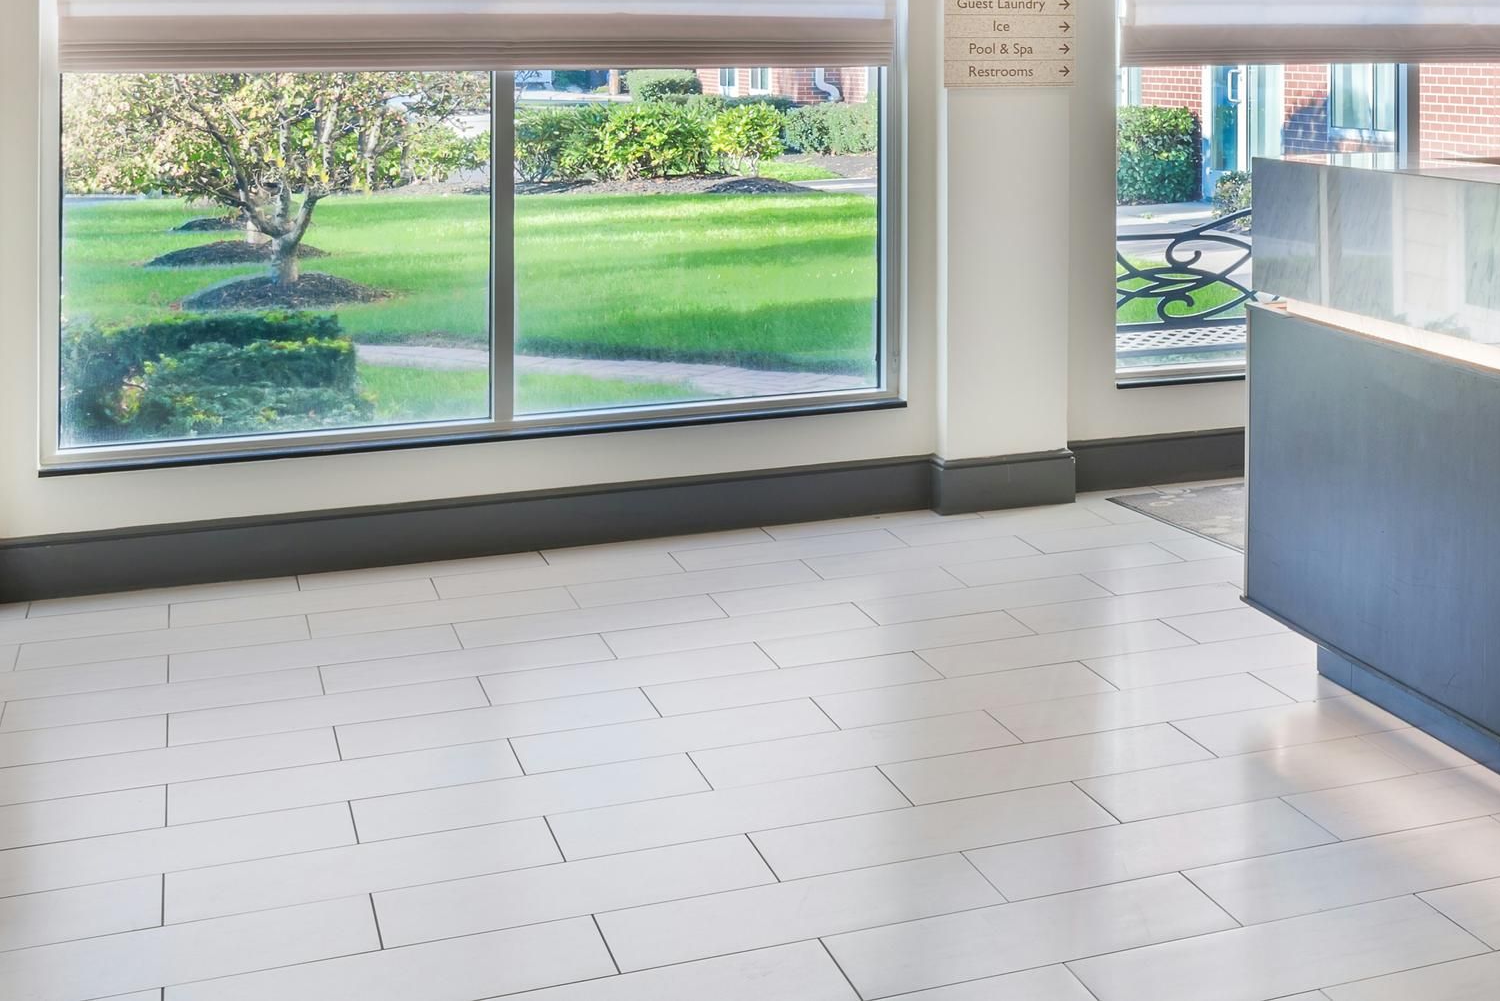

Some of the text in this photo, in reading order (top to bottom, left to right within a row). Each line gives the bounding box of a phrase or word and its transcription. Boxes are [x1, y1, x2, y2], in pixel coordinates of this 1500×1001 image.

[992, 19, 1011, 32] Ice
[968, 42, 1034, 58] Pool & Spa
[968, 65, 1034, 78] Restrooms
